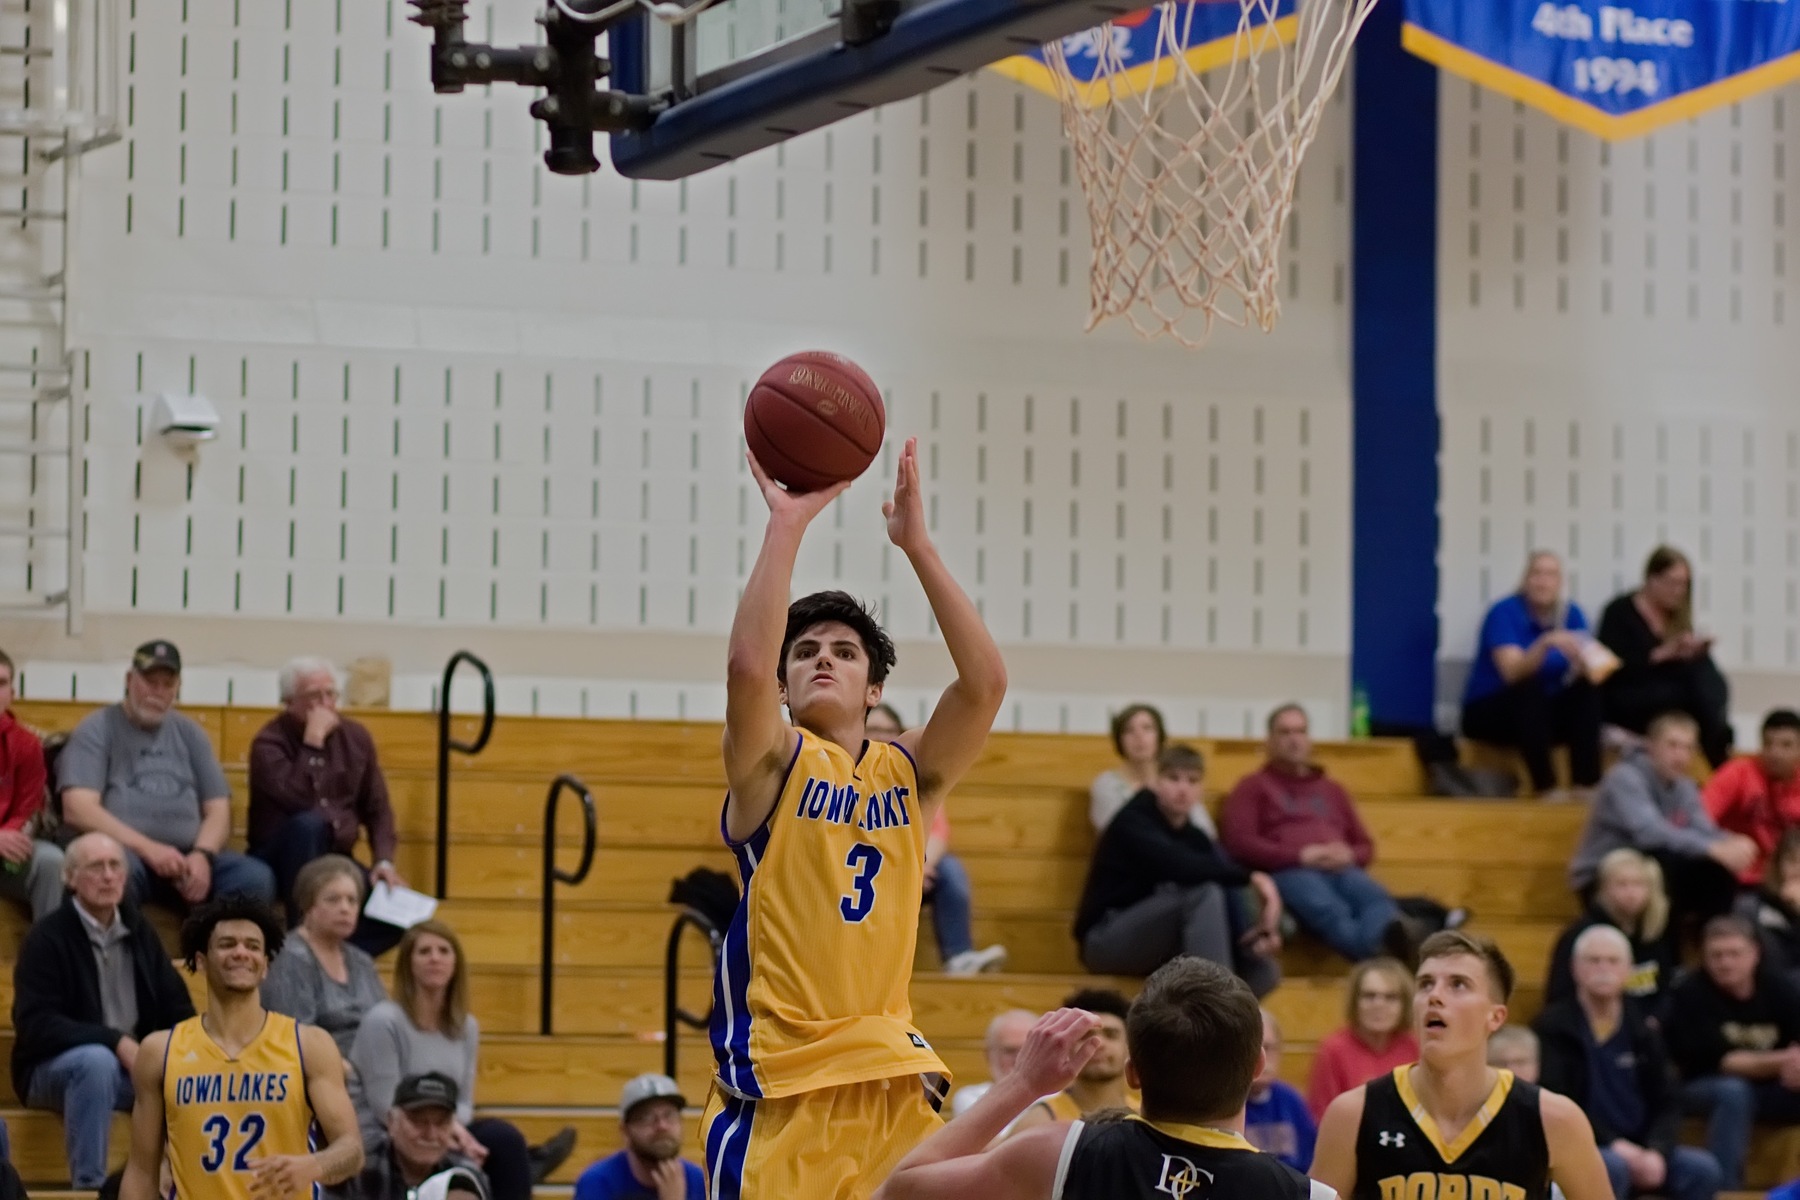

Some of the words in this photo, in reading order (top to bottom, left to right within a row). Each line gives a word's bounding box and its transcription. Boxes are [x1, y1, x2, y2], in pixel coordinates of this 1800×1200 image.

[1532, 2, 1593, 41] 4th
[1601, 6, 1695, 48] Place
[1574, 56, 1658, 96] 1994
[839, 842, 883, 924] 3
[176, 1074, 222, 1106] IOWA
[227, 1073, 289, 1102] LAKES
[201, 1113, 266, 1173] 32
